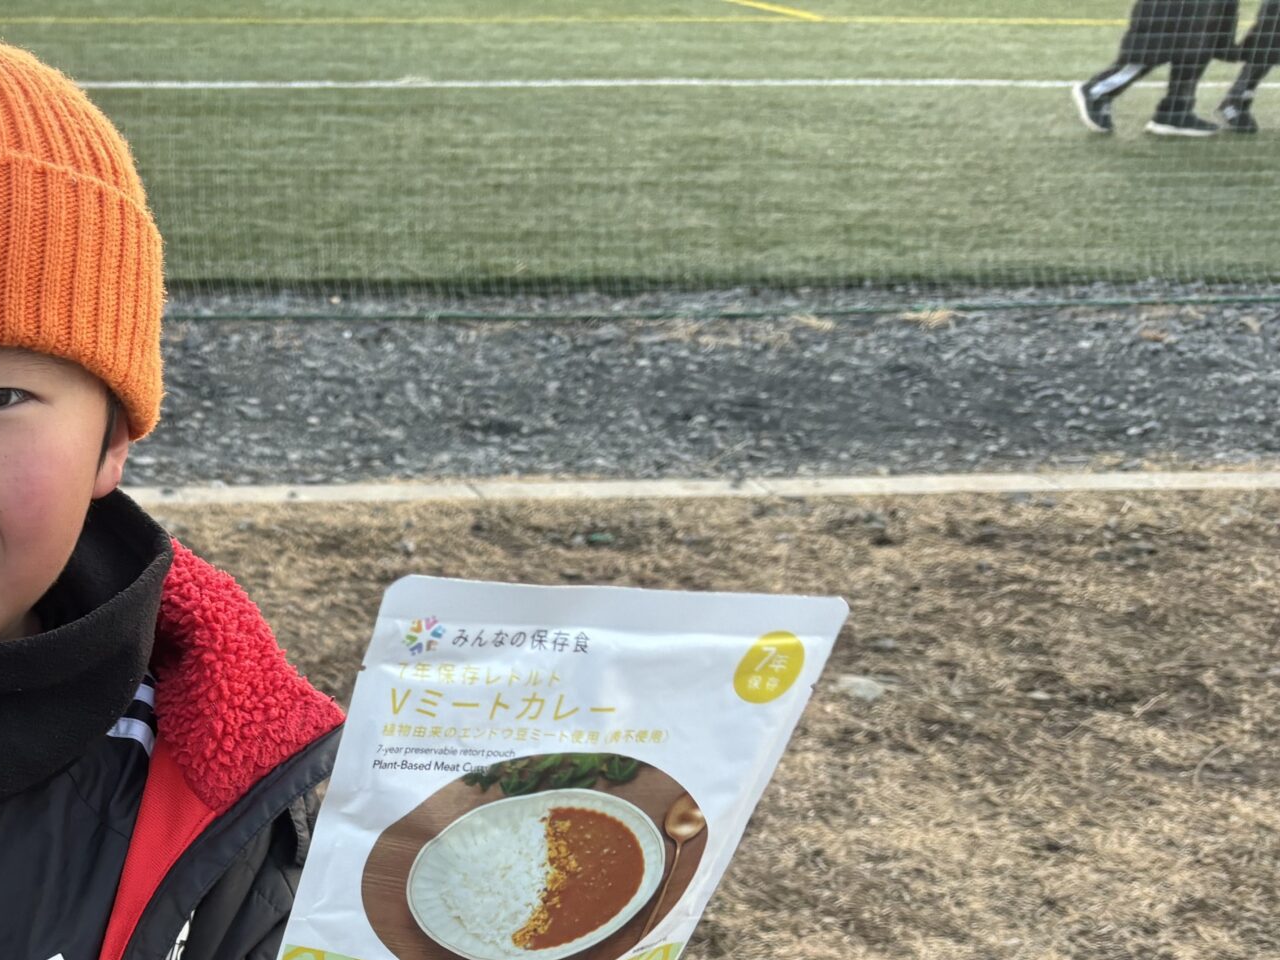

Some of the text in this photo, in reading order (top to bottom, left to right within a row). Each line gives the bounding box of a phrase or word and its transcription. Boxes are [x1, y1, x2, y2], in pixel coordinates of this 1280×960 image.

[452, 629, 590, 653] みんなの保存食
[398, 661, 561, 688] 7年保存レトルト
[390, 687, 616, 721] Vミートカレー
[376, 744, 516, 759] 7-year preservable retort pouch
[372, 759, 431, 771] Plant-Based
[434, 762, 459, 772] Meat
